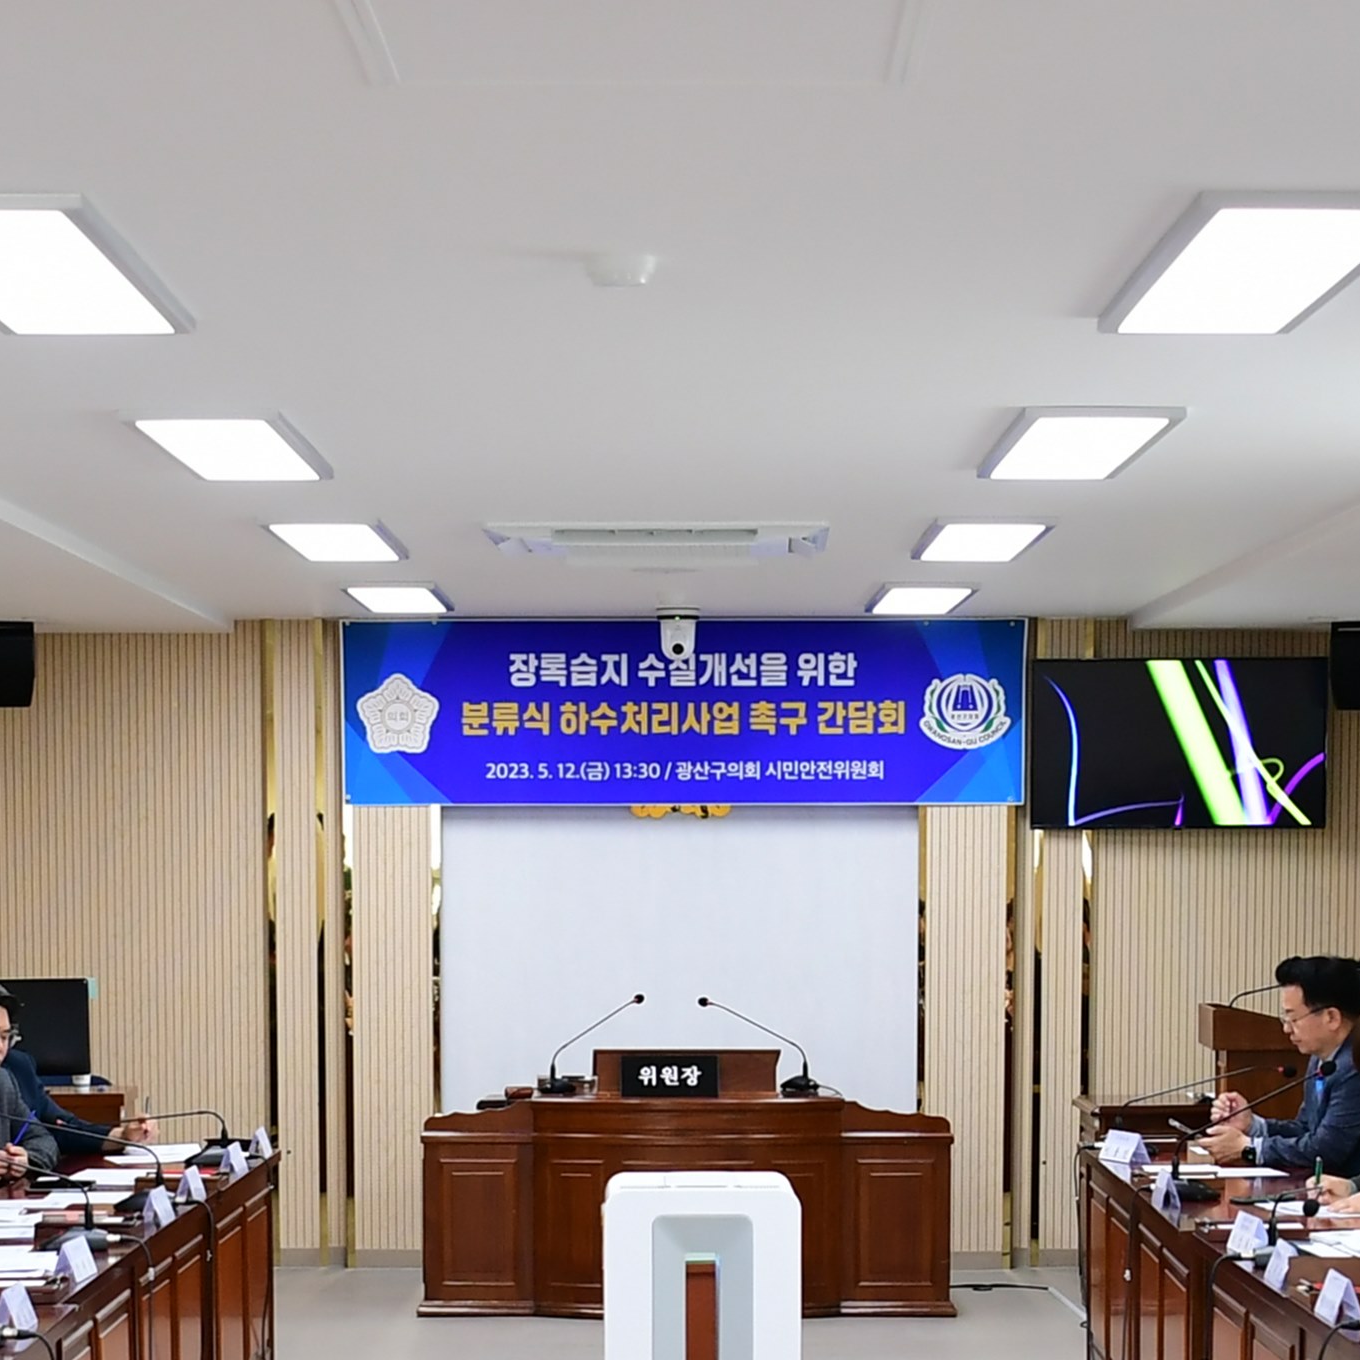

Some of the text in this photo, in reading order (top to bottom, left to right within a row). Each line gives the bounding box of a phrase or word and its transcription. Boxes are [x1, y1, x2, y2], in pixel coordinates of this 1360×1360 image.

[509, 652, 628, 687] 장록습지
[797, 652, 857, 687] 위한
[461, 699, 905, 736] 분류식 하수처리사업 촉구 간담회
[485, 760, 884, 781] 2023. 5. 12.(금) 13:30 / 광산구의회 시민안전위원회
[637, 1064, 702, 1087] 위원장
